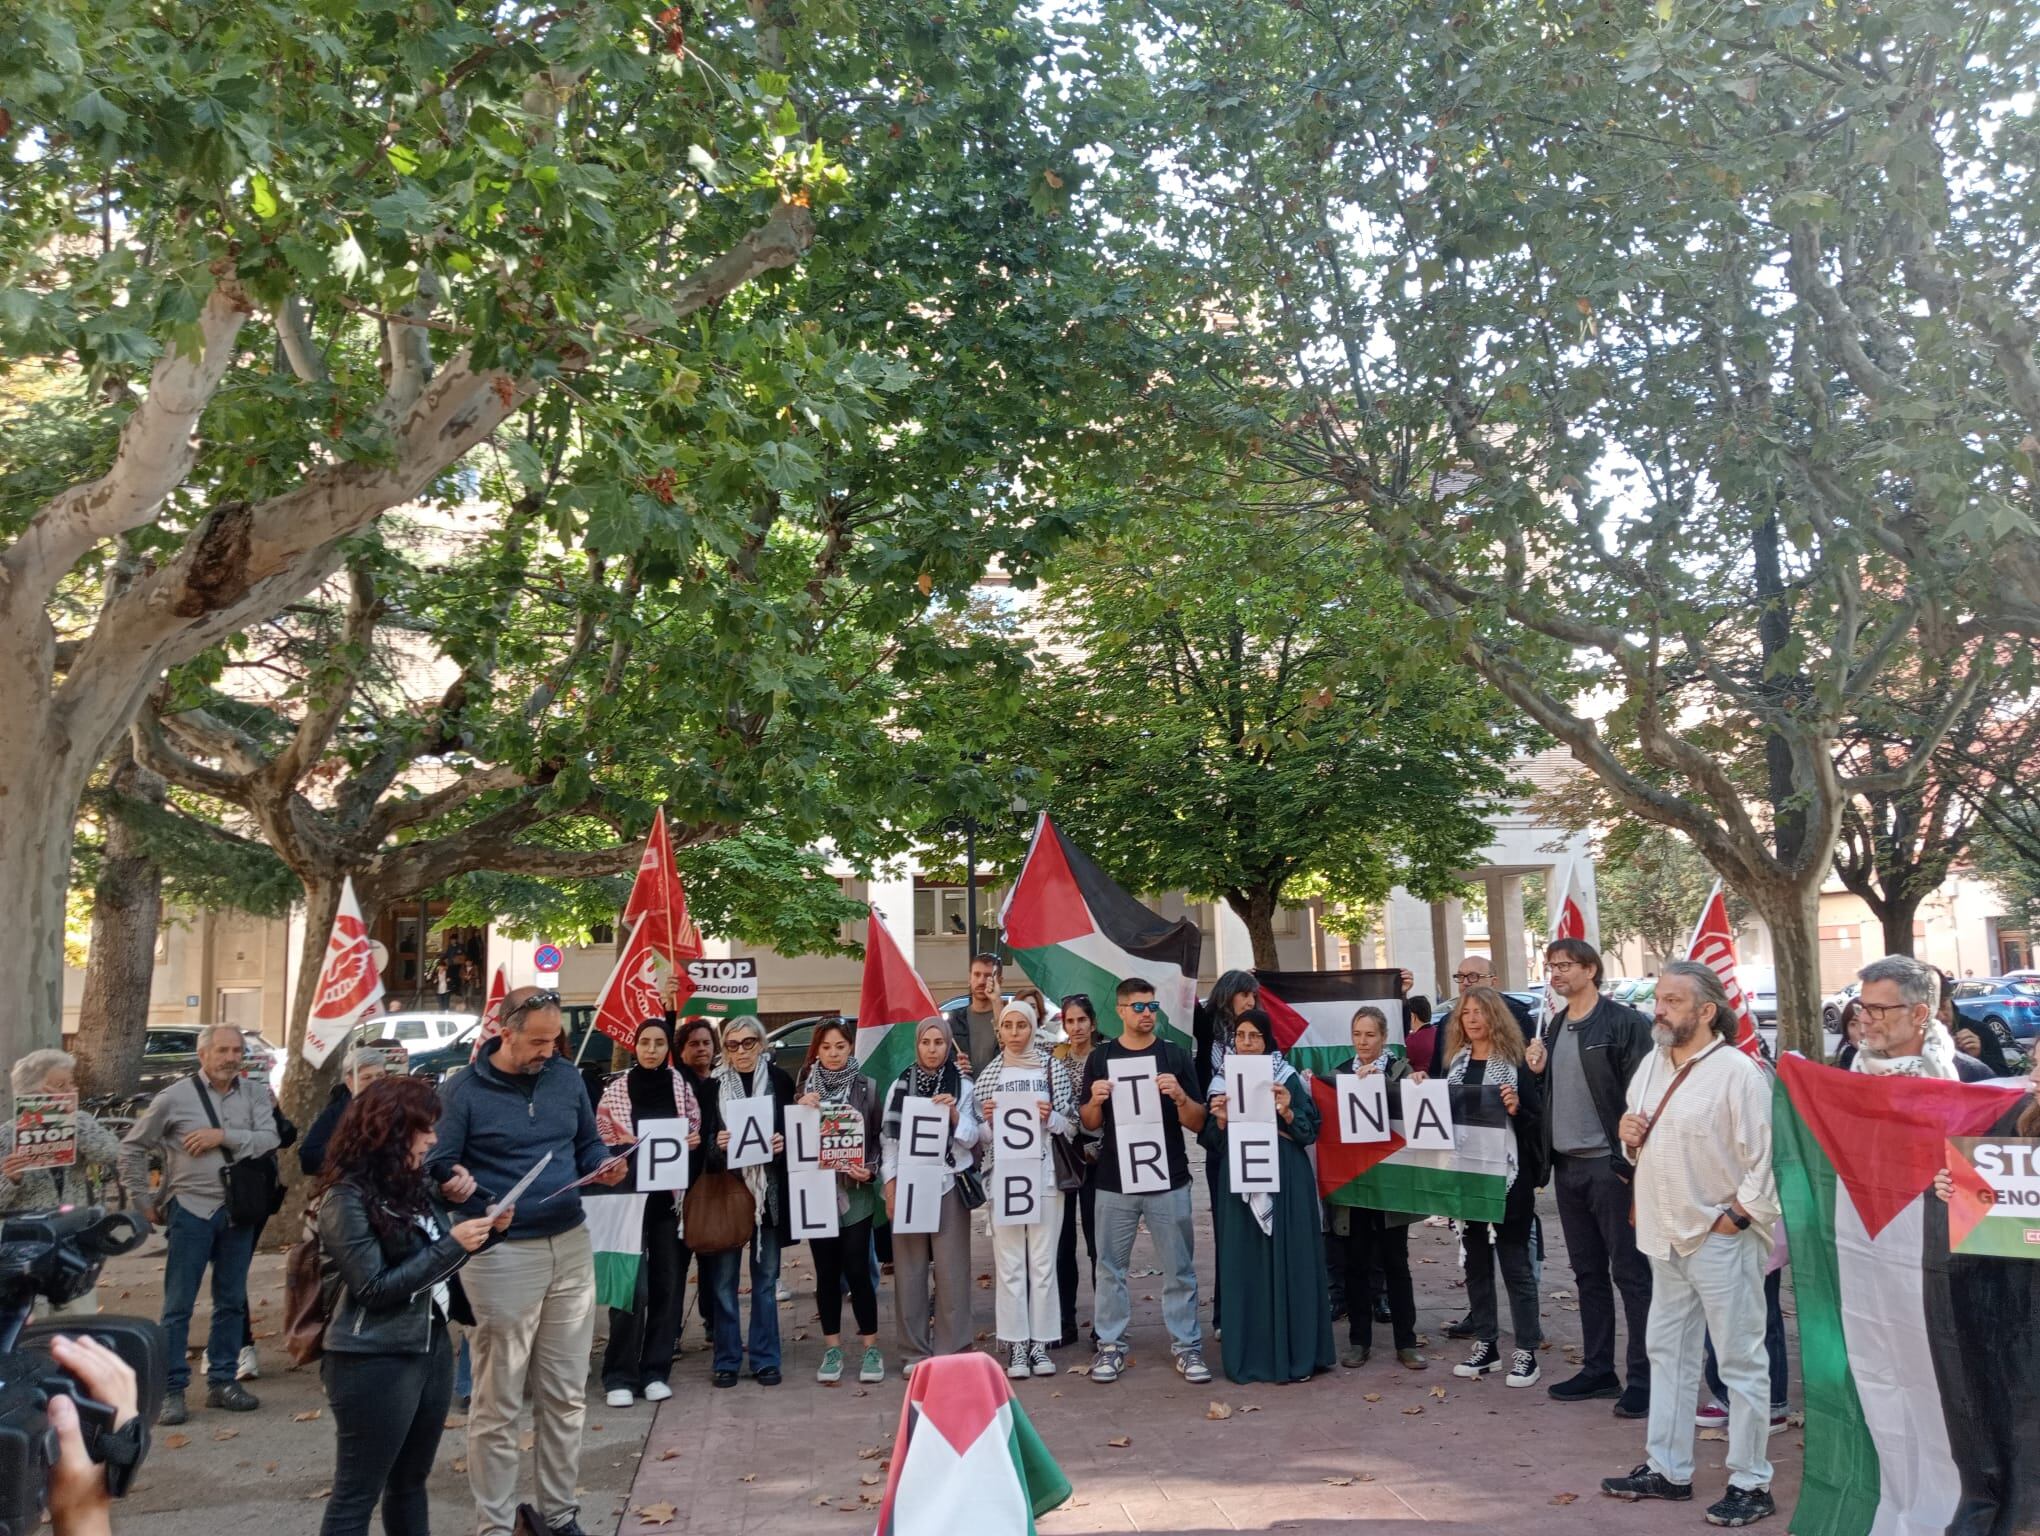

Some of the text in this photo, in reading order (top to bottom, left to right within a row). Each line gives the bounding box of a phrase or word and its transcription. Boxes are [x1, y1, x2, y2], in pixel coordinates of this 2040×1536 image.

[687, 961, 751, 979] STOP
[686, 984, 749, 994] GENOCIDIO
[606, 1024, 635, 1046] gt.es
[18, 1127, 75, 1145] STOP
[649, 1073, 1449, 1181] P A L E S T I N A
[822, 1135, 863, 1149] STOP
[800, 1141, 1272, 1230] L I B R E
